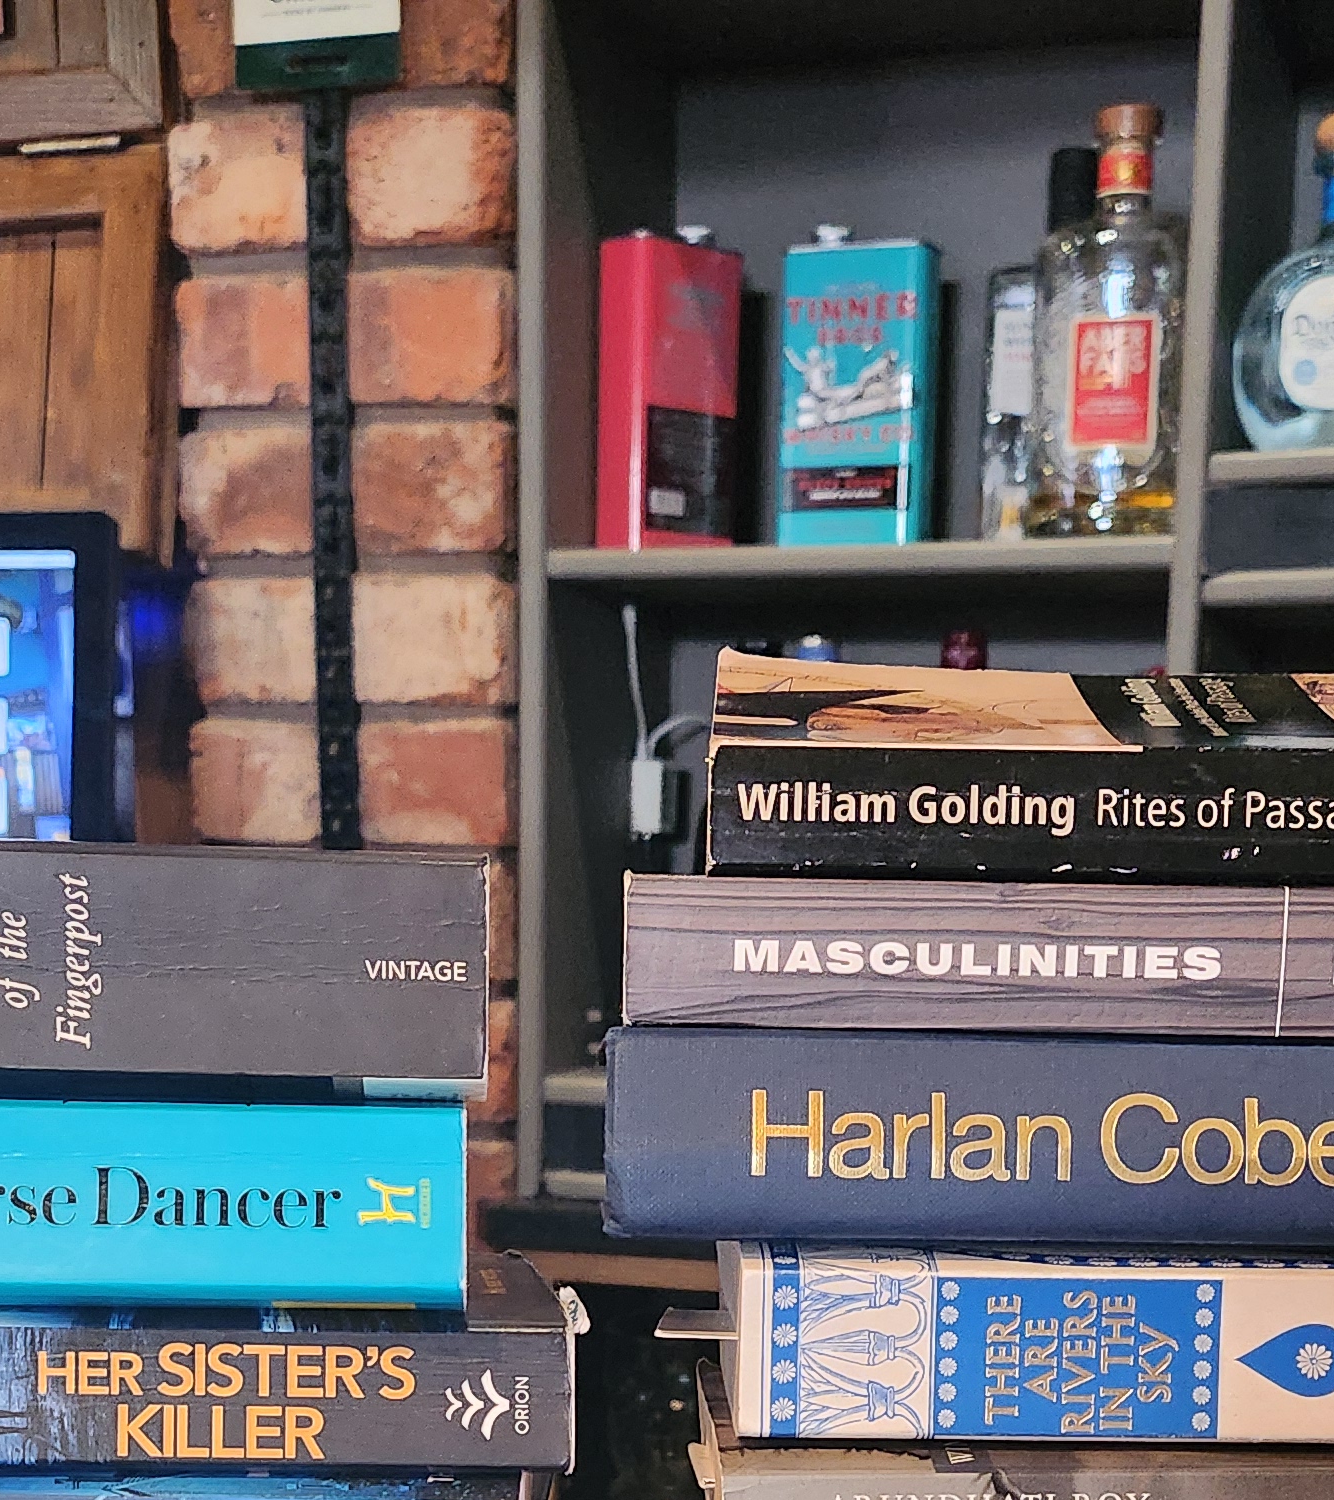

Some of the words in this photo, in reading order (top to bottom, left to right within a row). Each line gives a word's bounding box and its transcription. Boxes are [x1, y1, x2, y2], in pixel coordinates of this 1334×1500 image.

[737, 781, 896, 824] William
[908, 784, 1076, 837] Golding
[1097, 787, 1185, 828] Rites
[1196, 788, 1235, 829] of
[0, 911, 29, 961] the
[56, 873, 103, 1049] Fingerpost
[733, 939, 1223, 981] MASCULINITIES
[365, 959, 468, 983] VINTAGE
[750, 1088, 1072, 1182] Harlan
[91, 1164, 342, 1230] Dancer
[984, 1294, 1023, 1426] THERE
[1024, 1318, 1059, 1402] ARE
[1061, 1290, 1097, 1435] RIVERS
[1101, 1293, 1137, 1373] THE
[1137, 1324, 1180, 1403] SKY
[36, 1351, 144, 1397] HER
[156, 1342, 416, 1400] SISTER'S
[116, 1404, 326, 1460] KILLER
[514, 1376, 530, 1435] ORION
[1100, 1376, 1134, 1431] IN
